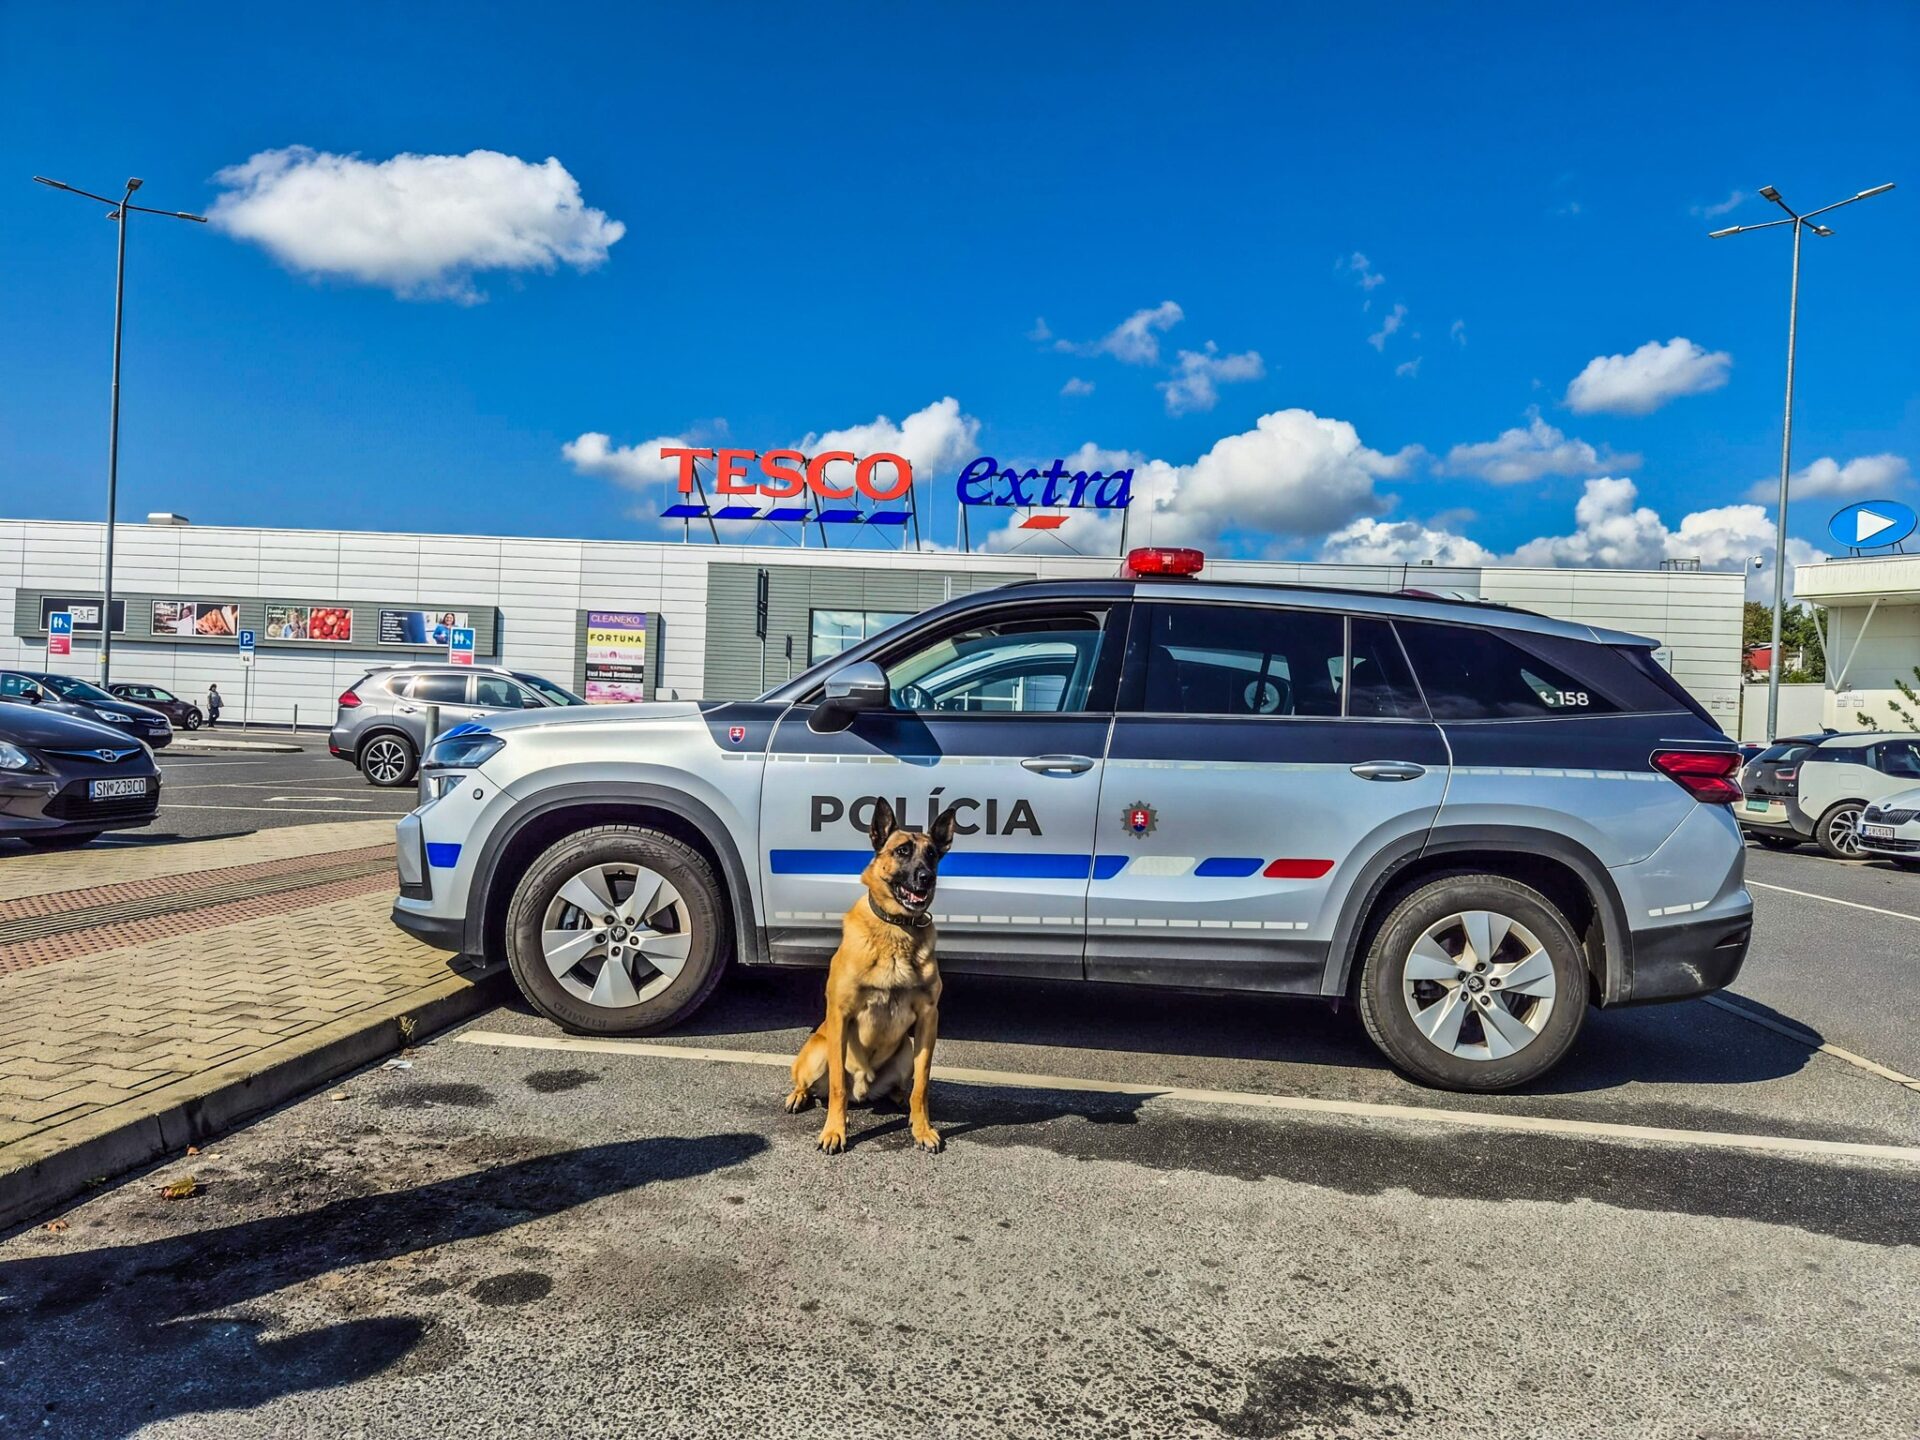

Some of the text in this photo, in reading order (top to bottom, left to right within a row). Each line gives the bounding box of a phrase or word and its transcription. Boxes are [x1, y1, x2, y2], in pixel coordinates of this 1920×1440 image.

[661, 448, 1135, 508] TESCO extra
[591, 614, 640, 625] CLEANEKO
[590, 633, 642, 643] FORTUNA
[1555, 691, 1590, 706] 158
[96, 781, 109, 796] SN
[810, 787, 1043, 836] POLÍCIA
